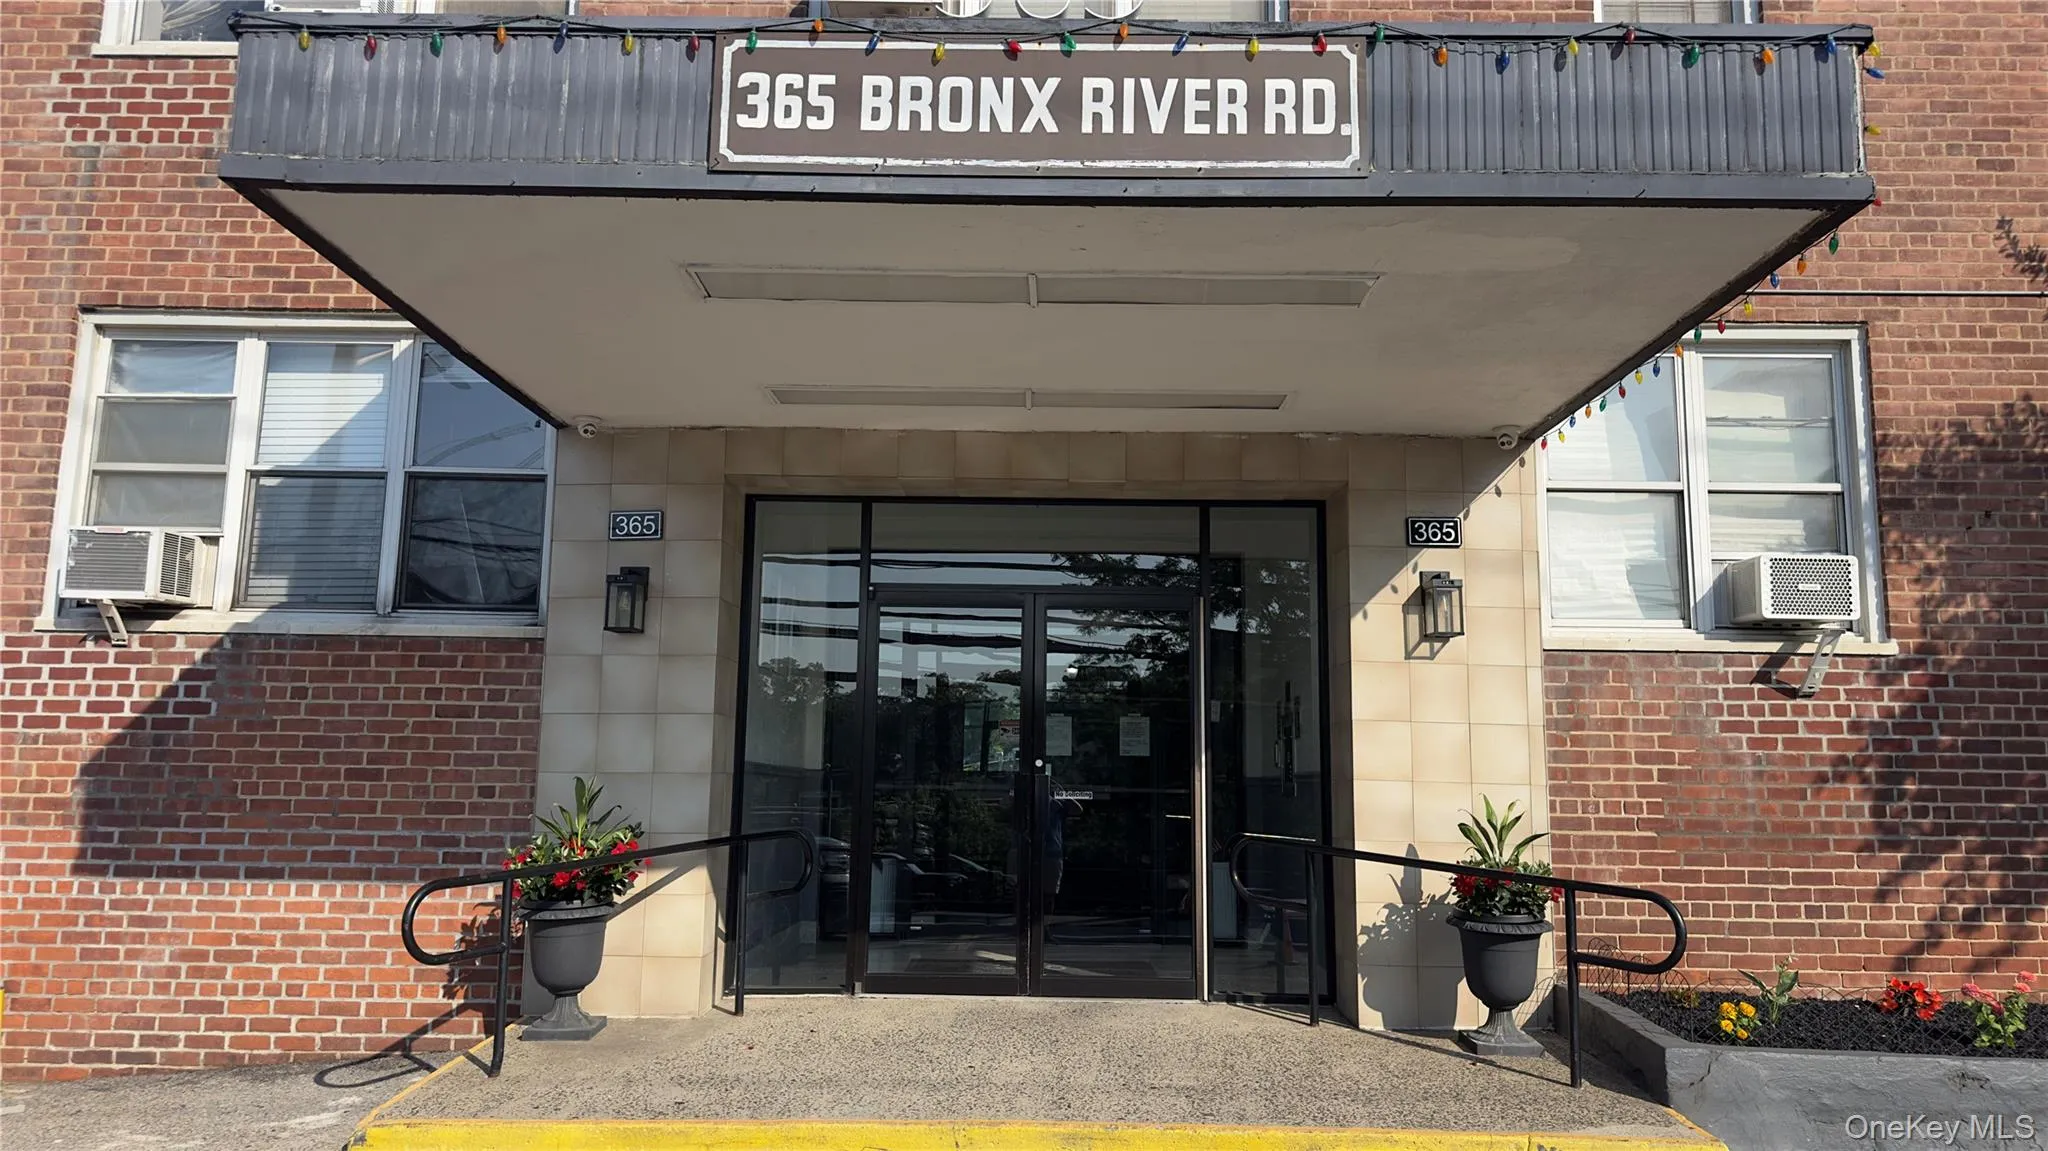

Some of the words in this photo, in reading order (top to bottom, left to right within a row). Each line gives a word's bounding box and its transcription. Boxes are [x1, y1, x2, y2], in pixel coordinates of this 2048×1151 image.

[735, 71, 836, 130] 365
[860, 74, 1062, 134] BRONX
[1081, 76, 1248, 135] RIVER
[1264, 78, 1352, 136] RD.
[615, 515, 656, 535] 365
[1414, 521, 1456, 542] 365
